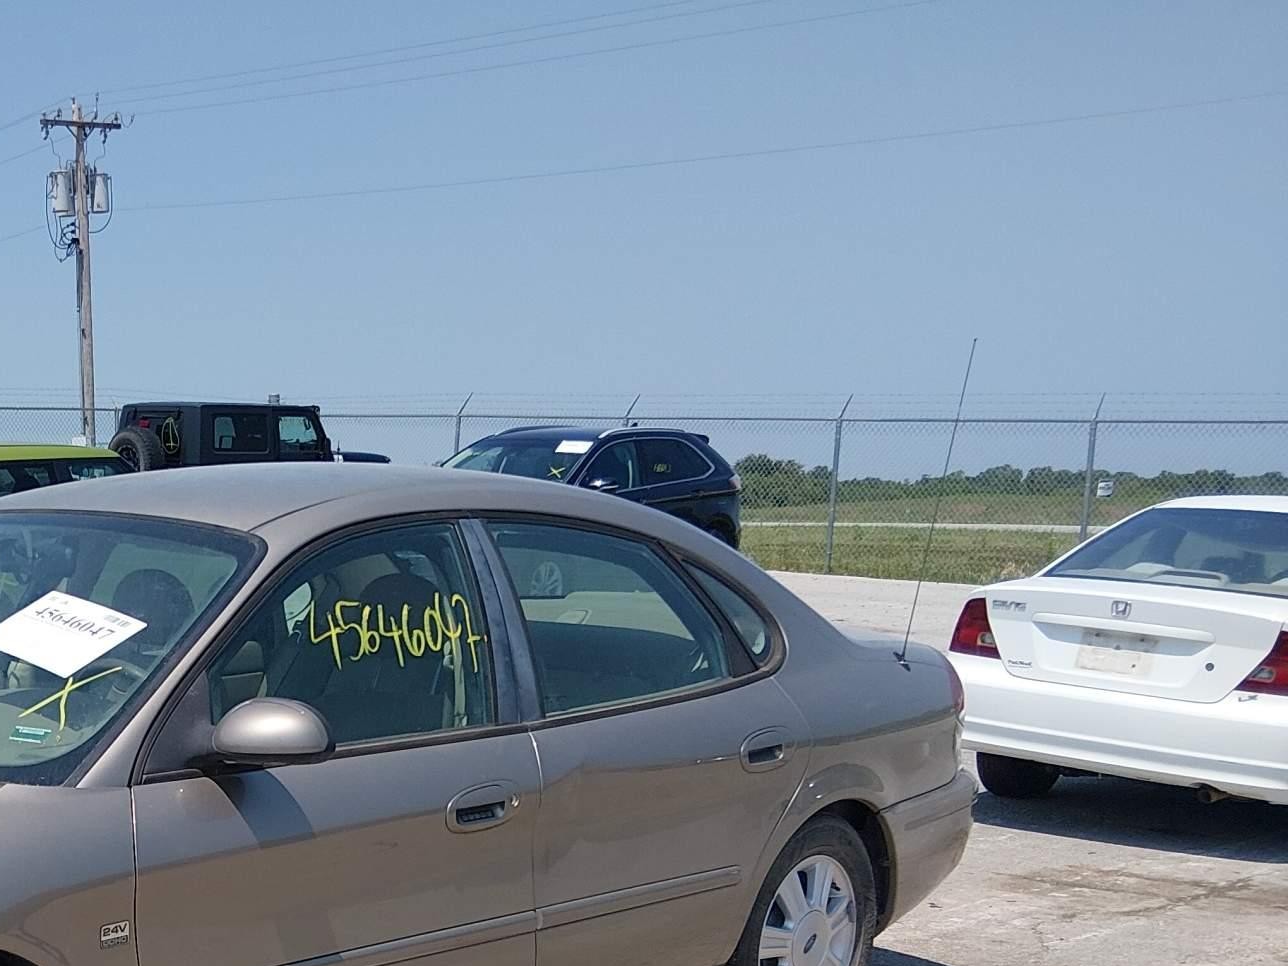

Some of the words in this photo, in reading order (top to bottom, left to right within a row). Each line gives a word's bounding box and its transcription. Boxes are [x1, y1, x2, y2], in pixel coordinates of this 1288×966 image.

[34, 606, 116, 641] 45646047
[307, 591, 481, 674] 45646047
[102, 922, 128, 937] 24V
